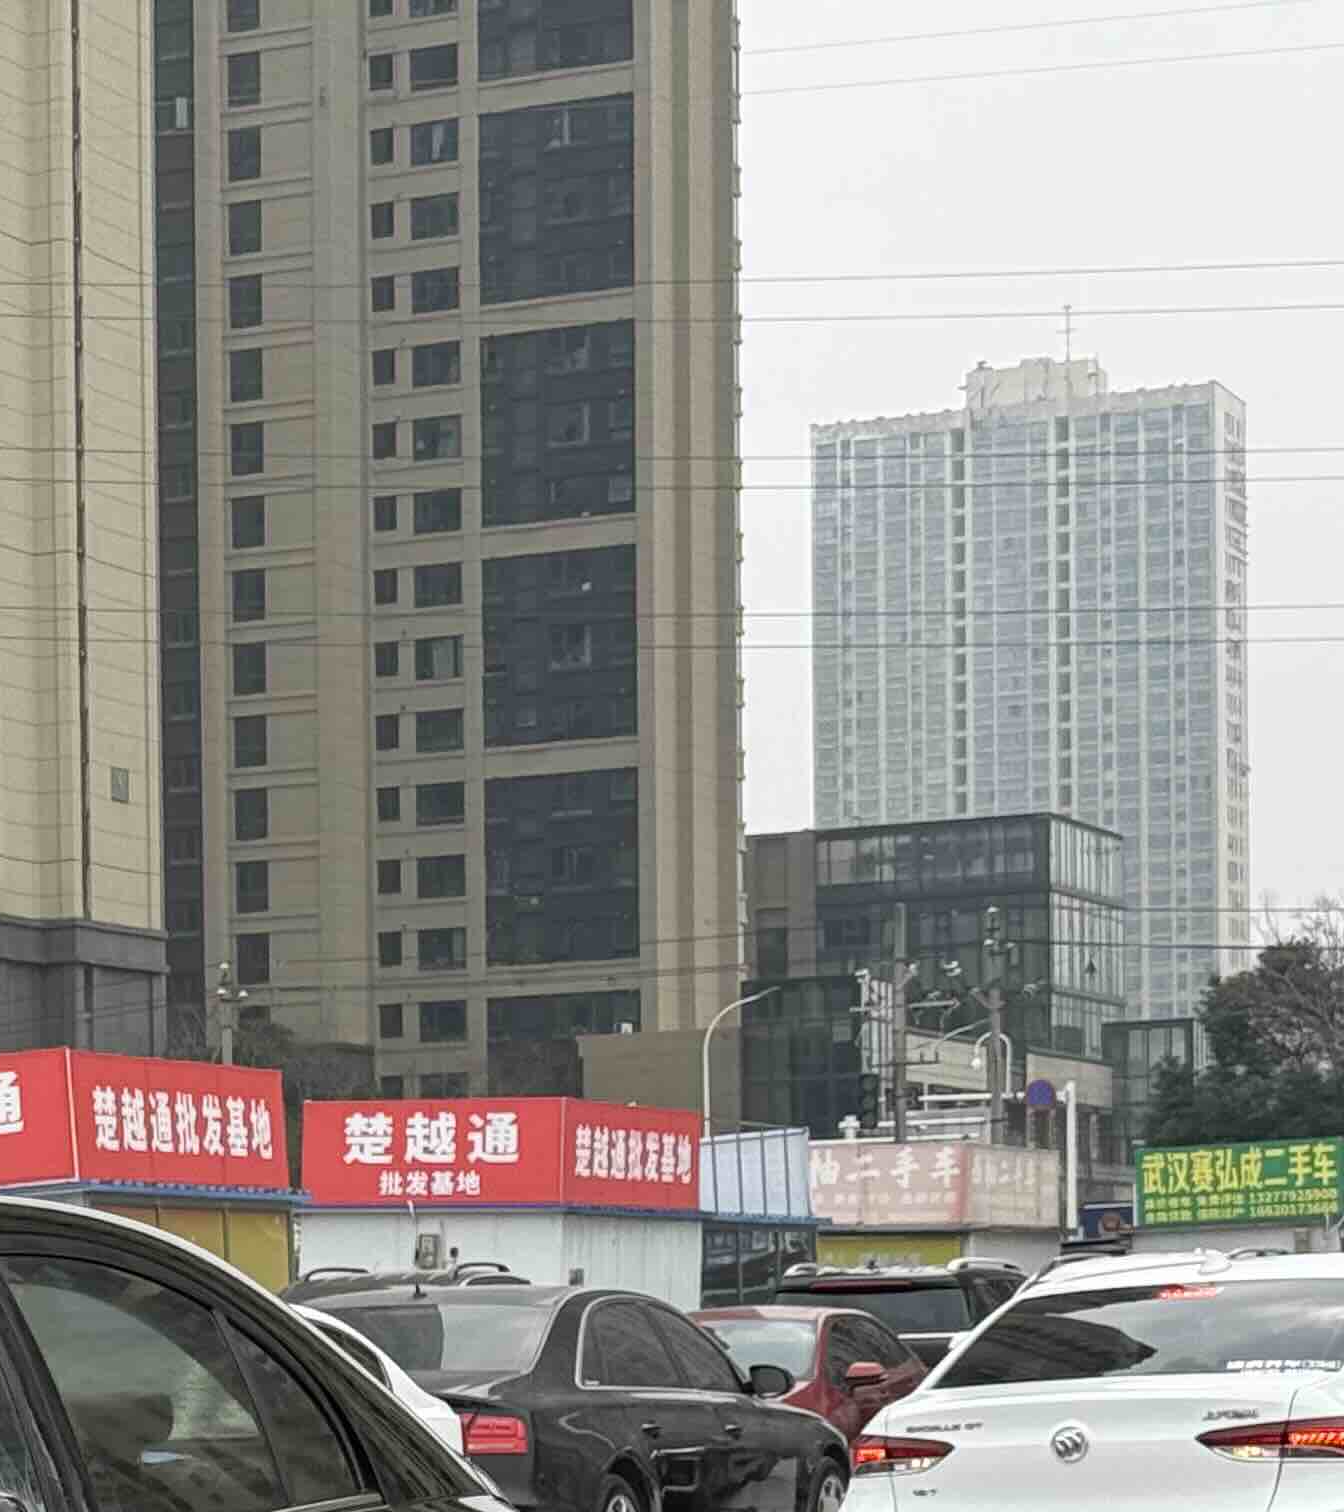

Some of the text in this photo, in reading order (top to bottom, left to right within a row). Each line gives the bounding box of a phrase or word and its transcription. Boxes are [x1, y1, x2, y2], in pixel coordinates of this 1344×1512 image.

[92, 1085, 275, 1161] 楚越通批发基地
[342, 1111, 520, 1165] 楚越通
[575, 1123, 693, 1185] 楚越通批发基地
[1141, 1143, 1338, 1194] 武汉赛弘成二手车
[378, 1170, 481, 1197] 批发基地
